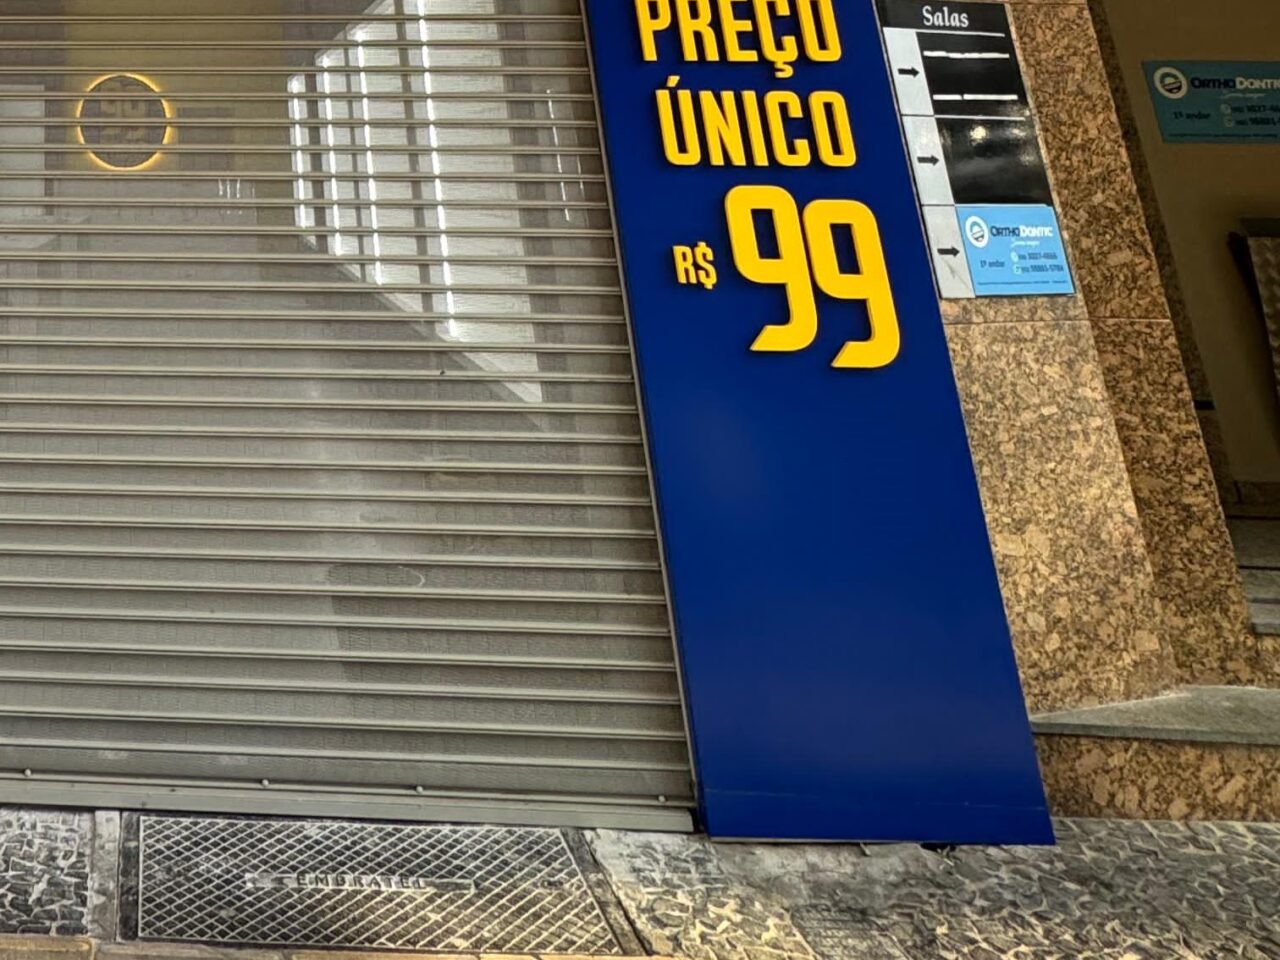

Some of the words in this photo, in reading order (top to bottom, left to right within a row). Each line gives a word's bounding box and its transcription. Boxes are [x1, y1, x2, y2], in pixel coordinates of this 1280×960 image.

[922, 5, 969, 28] Salas
[655, 75, 857, 168] ÚNICO
[672, 242, 718, 290] R$
[724, 185, 901, 369] 99
